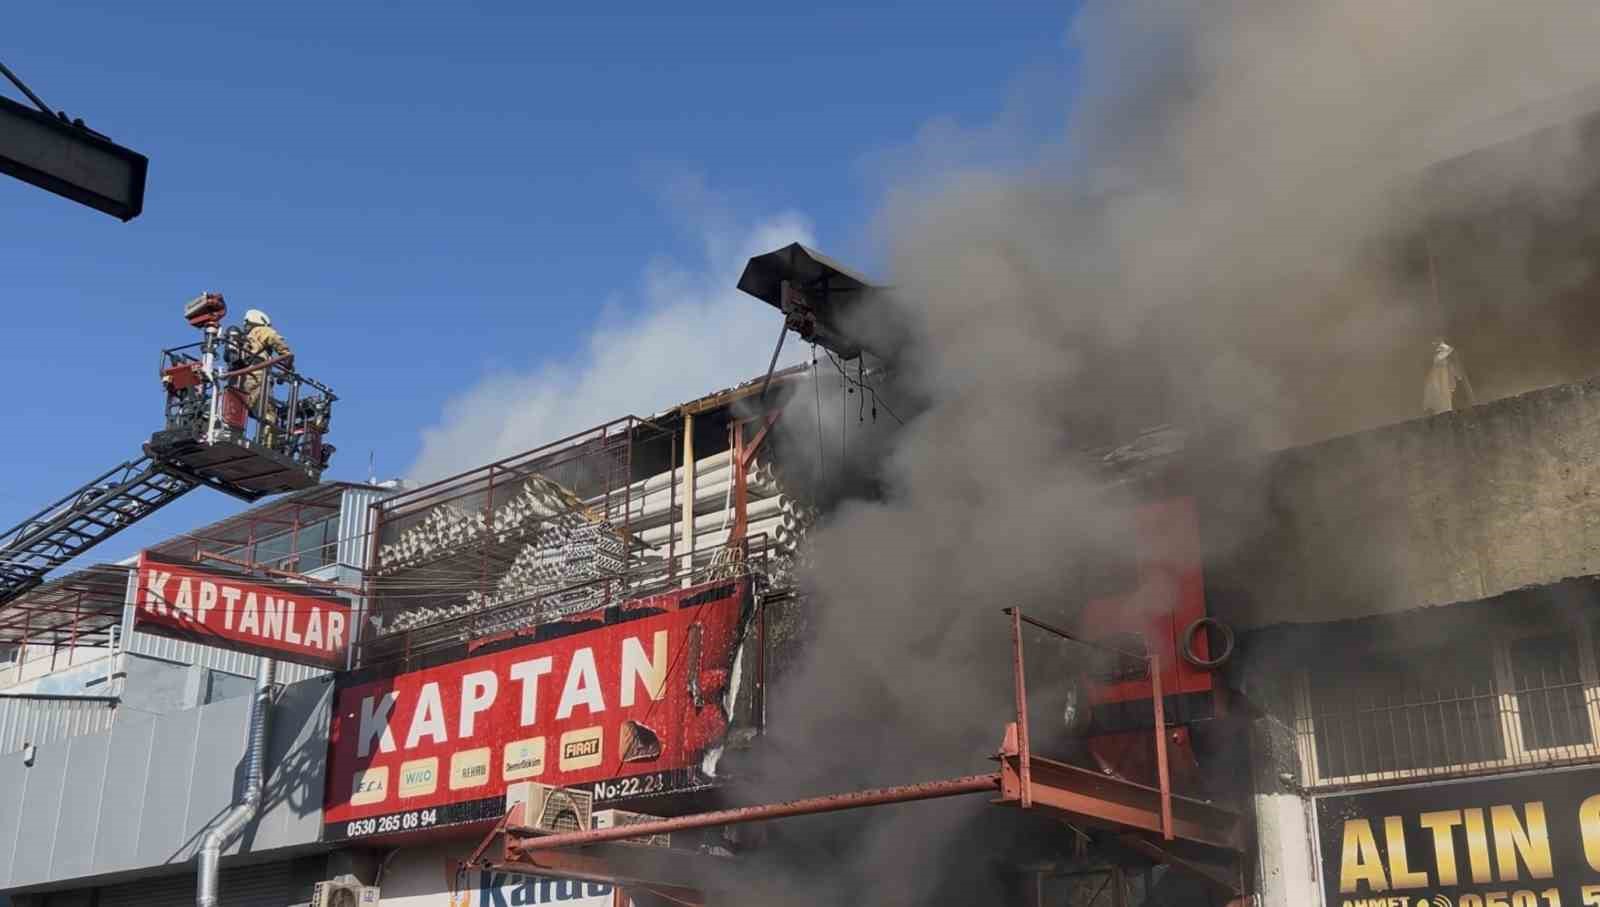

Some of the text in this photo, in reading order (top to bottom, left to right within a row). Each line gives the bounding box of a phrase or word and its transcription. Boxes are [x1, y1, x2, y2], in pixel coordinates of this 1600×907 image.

[145, 569, 345, 651] KAPTANLAR
[357, 630, 668, 758] KAPTAN
[566, 740, 598, 758] FIRAT
[347, 809, 437, 837] 0530 265 08 94
[1340, 801, 1554, 894] ALTIN
